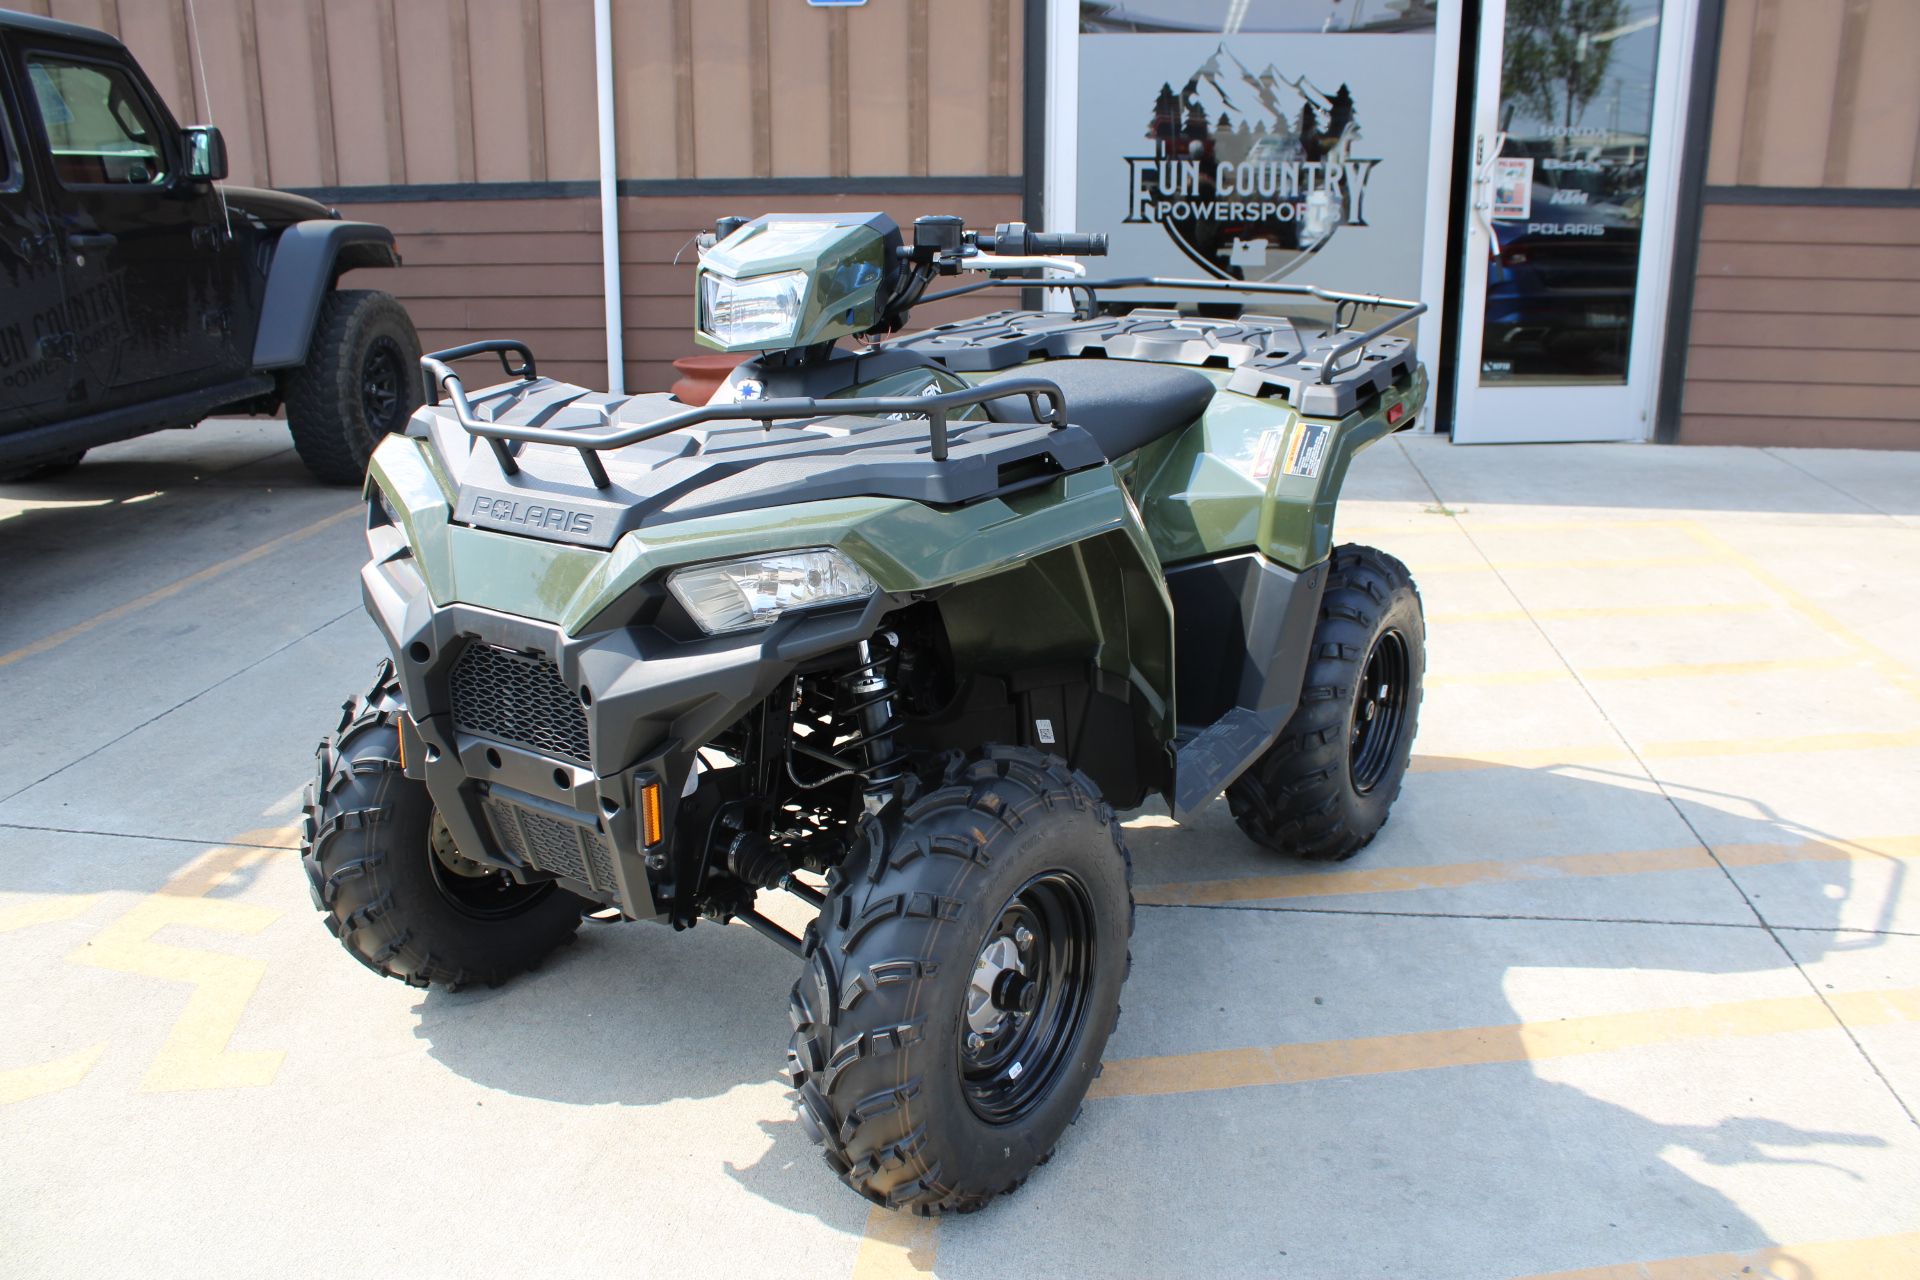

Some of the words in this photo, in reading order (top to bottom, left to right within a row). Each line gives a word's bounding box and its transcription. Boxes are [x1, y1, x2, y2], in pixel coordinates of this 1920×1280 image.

[1539, 125, 1608, 138] HONDA
[1128, 158, 1200, 221] FUN
[1216, 159, 1374, 224] COUNTRY
[1550, 189, 1590, 205] KTM
[1528, 223, 1605, 235] POLARIS
[472, 495, 595, 535] POLARIS
